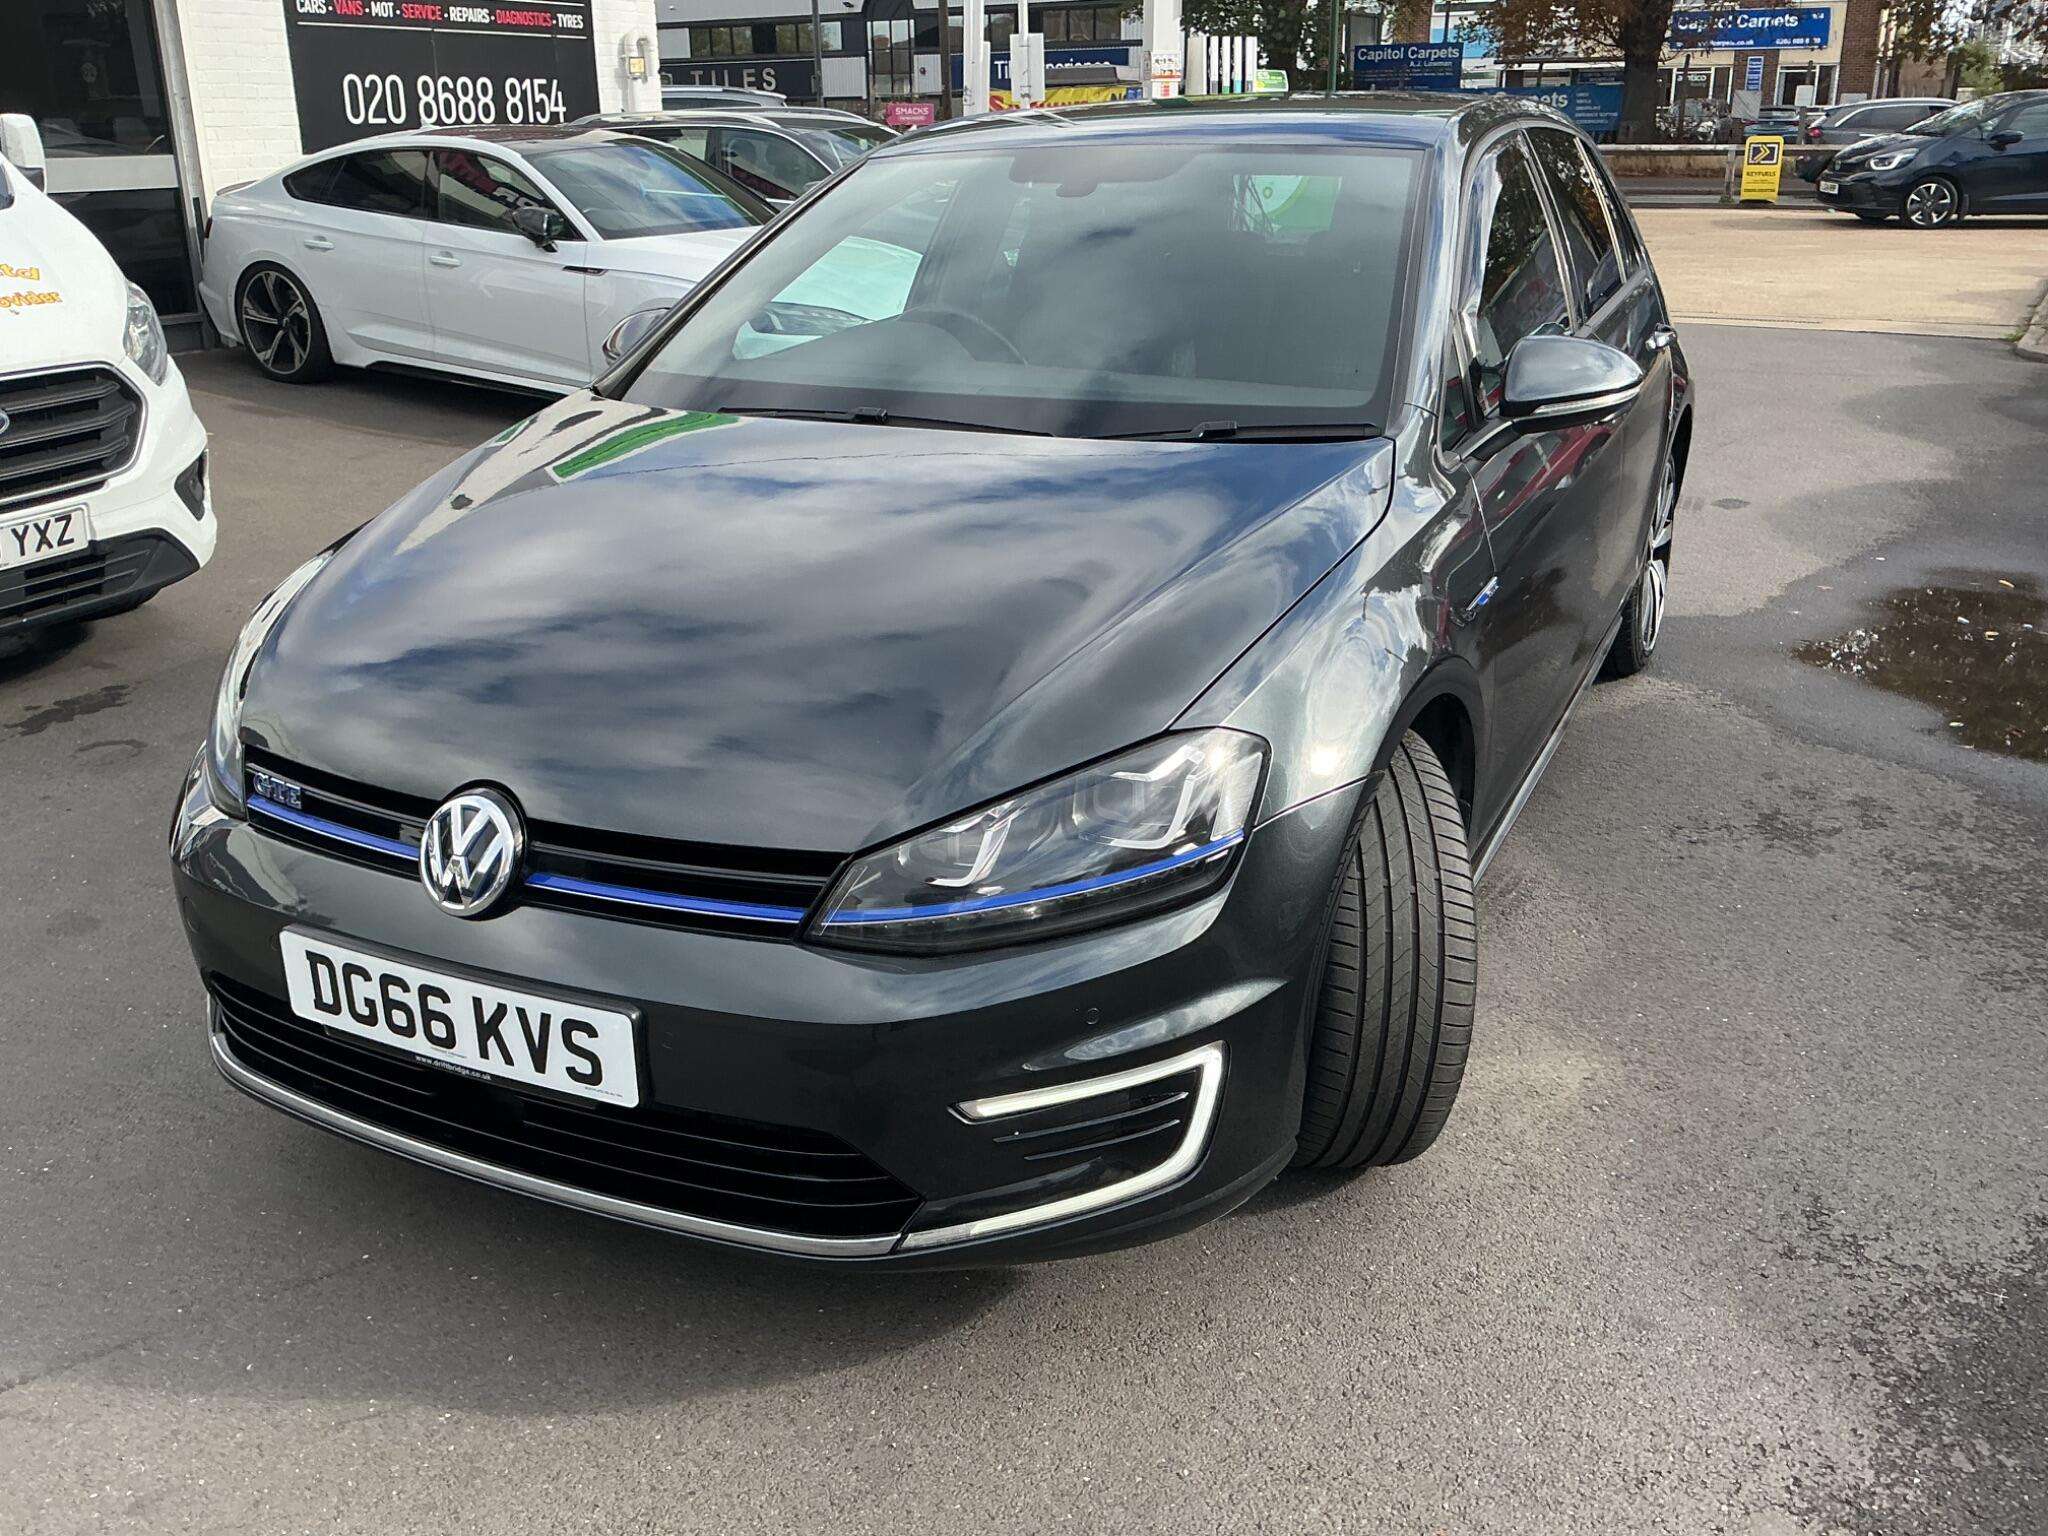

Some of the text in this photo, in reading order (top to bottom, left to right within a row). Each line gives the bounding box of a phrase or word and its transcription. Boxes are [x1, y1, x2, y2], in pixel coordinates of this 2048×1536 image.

[296, 0, 584, 29] CARS VANS MOT SERVICE REPAIRS DIAGNOSTICS TYRES
[1358, 46, 1460, 62] Capitol Carpets
[343, 73, 567, 125] 020 8688 8154
[11, 513, 75, 557] YXZ
[253, 772, 302, 810] GTE
[305, 949, 604, 1087] DG66 KVS
